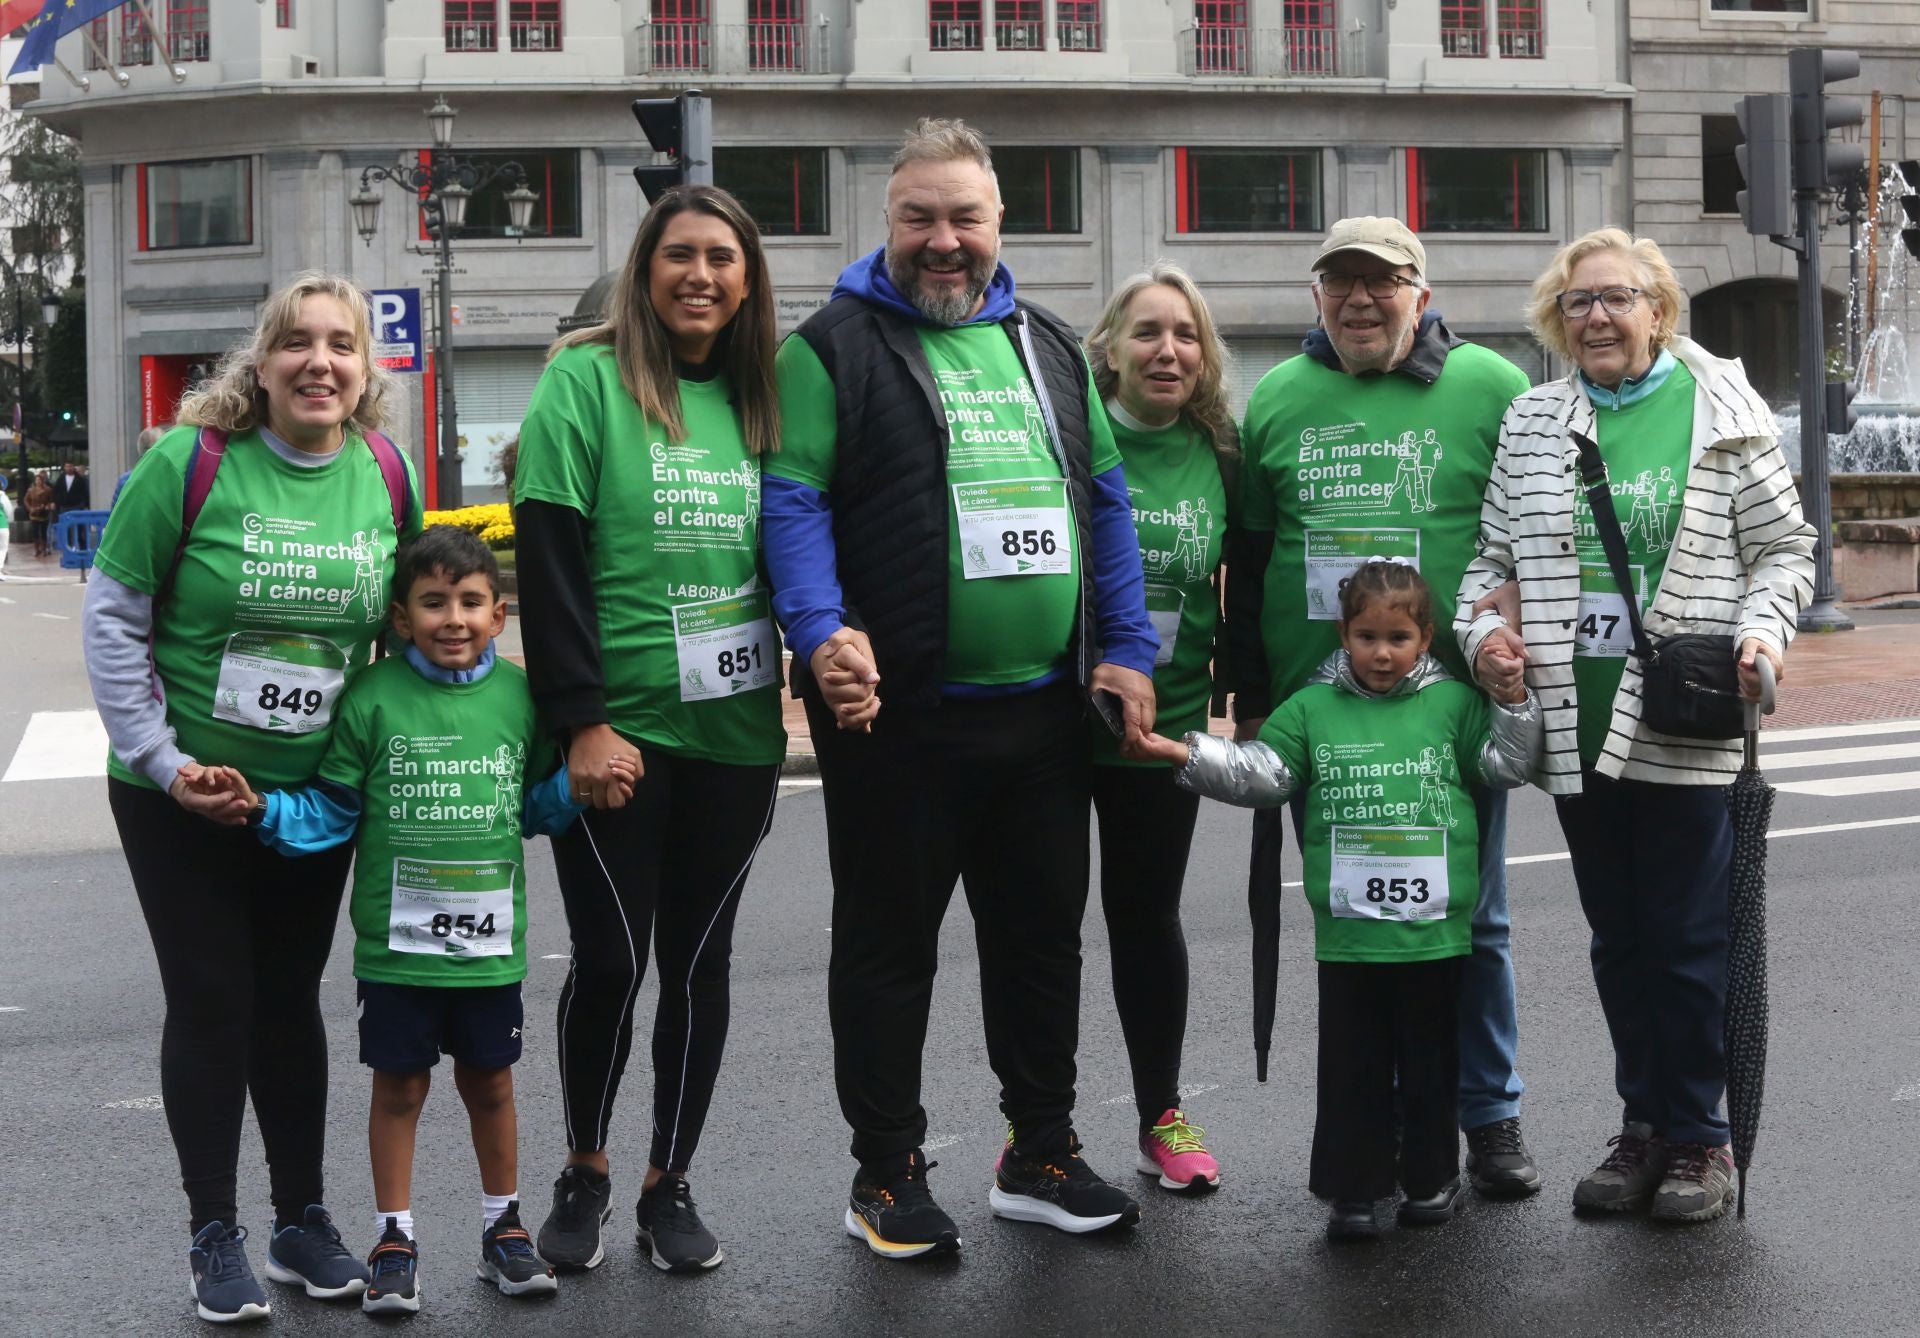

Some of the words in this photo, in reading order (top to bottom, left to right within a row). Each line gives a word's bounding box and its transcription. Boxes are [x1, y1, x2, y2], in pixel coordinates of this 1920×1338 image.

[780, 300, 818, 310] Seguridad
[373, 294, 406, 341] P
[940, 389, 954, 403] n
[957, 386, 1029, 404] marcha
[944, 408, 995, 424] ontra
[949, 426, 955, 444] l
[962, 426, 1027, 443] cáncer
[1299, 446, 1324, 463] En
[1332, 440, 1409, 459] marcha
[652, 463, 680, 482] En
[686, 468, 751, 486] marcha
[1298, 462, 1362, 481] contra
[654, 486, 718, 505] contra
[960, 488, 988, 497] Oviedo
[1030, 484, 1051, 492] contra
[1299, 484, 1315, 501] el
[1322, 481, 1393, 499] cáncer
[1609, 480, 1645, 496] cha
[962, 498, 970, 506] el
[972, 497, 998, 505] cáncer
[654, 507, 673, 526] el
[681, 507, 744, 528] cáncer
[1130, 508, 1187, 526] archa
[244, 534, 274, 554] En
[282, 542, 364, 560] marcha
[1001, 529, 1056, 556] 856
[1139, 548, 1171, 564] cer
[242, 560, 317, 580] contra
[239, 578, 261, 598] el
[269, 580, 350, 602] cáncer
[679, 609, 706, 619] Oviedo
[690, 618, 715, 627] cáncer
[1576, 614, 1620, 639] 47
[718, 642, 761, 677] 851
[258, 683, 322, 716] 849
[388, 757, 418, 776] En
[426, 756, 505, 774] marcha
[1317, 764, 1341, 781] En
[1349, 758, 1431, 778] marcha
[390, 780, 462, 798] contra
[1321, 782, 1384, 800] contra
[389, 801, 407, 820] el
[416, 800, 494, 820] cáncer
[1323, 802, 1336, 820] el
[1343, 802, 1418, 819] cáncer
[400, 864, 429, 874] Oviedo
[476, 868, 498, 876] contra
[409, 874, 438, 883] cáncer
[1366, 878, 1430, 903] 853
[431, 913, 496, 938] 854
